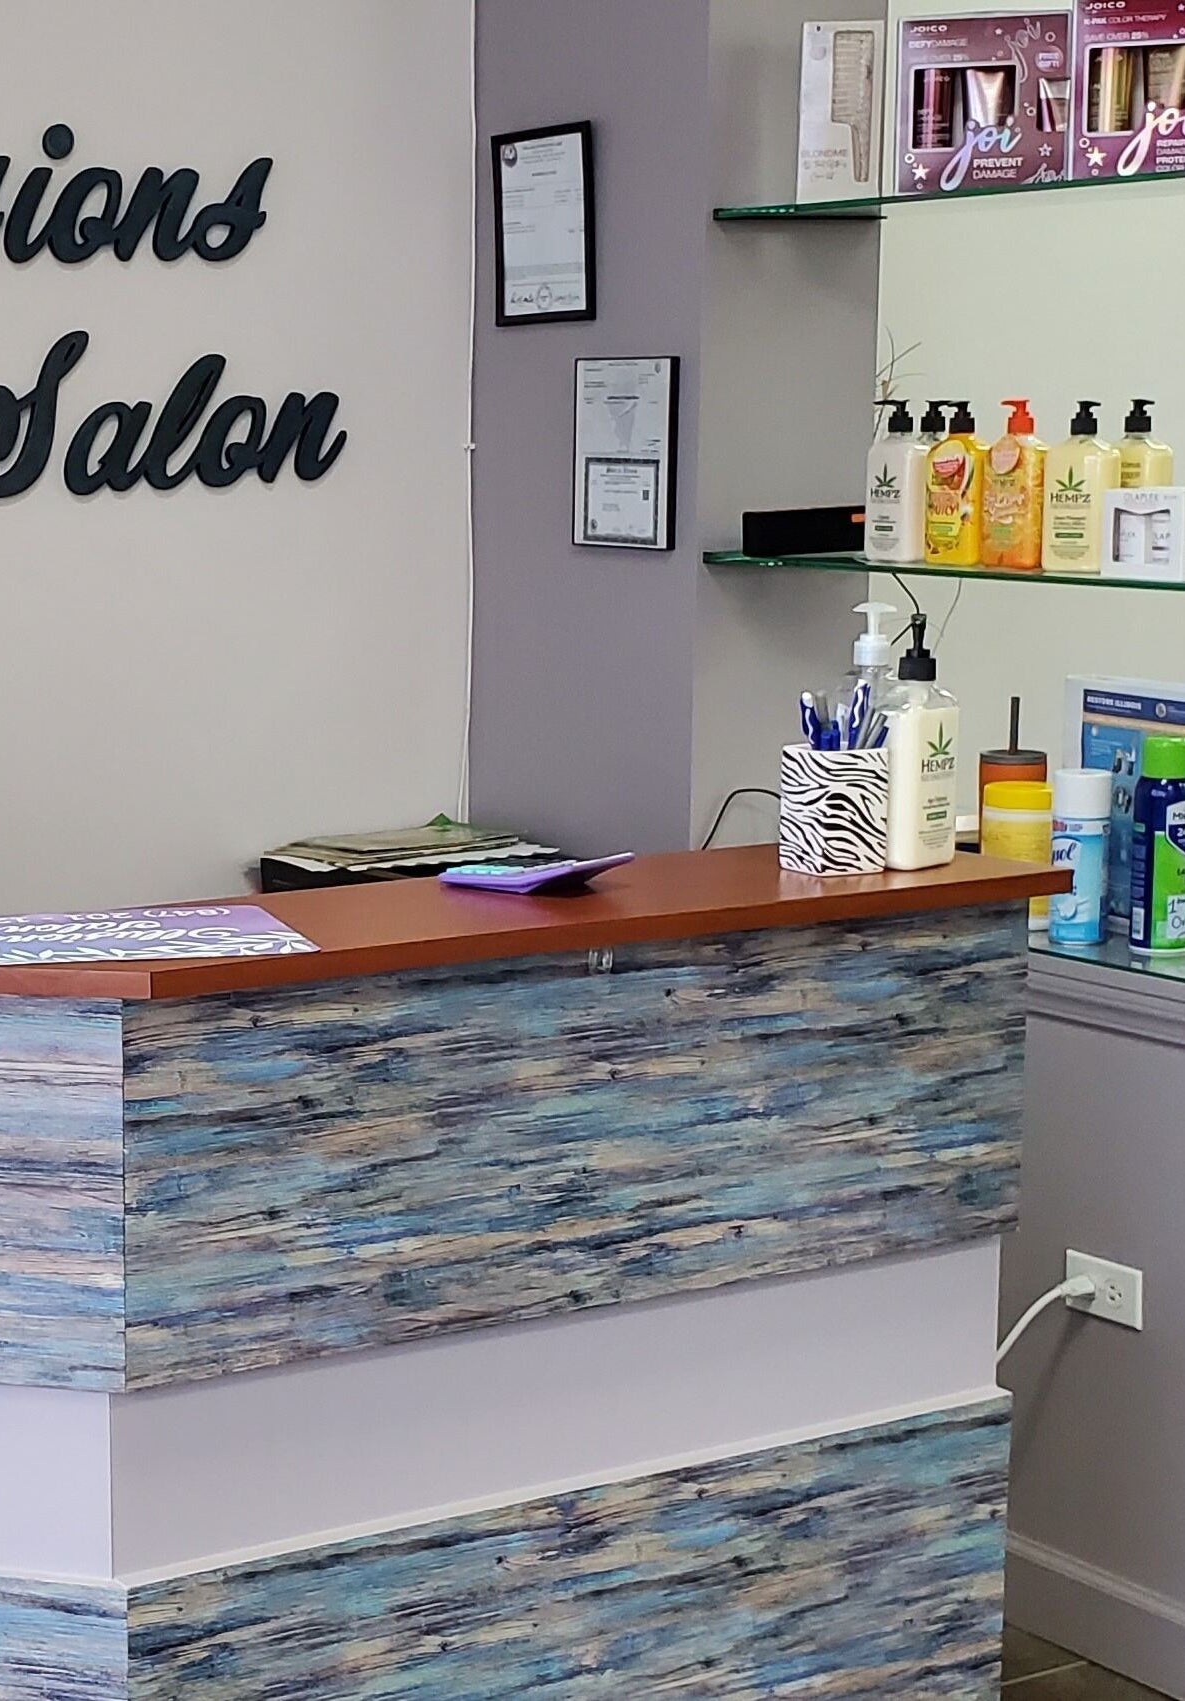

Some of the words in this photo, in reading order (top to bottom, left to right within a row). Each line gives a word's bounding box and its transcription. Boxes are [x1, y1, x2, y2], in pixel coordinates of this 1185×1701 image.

[1084, 1, 1126, 10] JOICO
[1108, 15, 1133, 24] COLOR
[909, 24, 948, 33] JOICO
[939, 115, 1023, 192] joi
[972, 157, 1023, 169] PREVENT
[972, 168, 1018, 180] DAMAGE
[870, 488, 901, 499] HEMPZ
[1050, 492, 1091, 504] HEMPZ
[921, 757, 955, 773] HEMPZ
[64, 911, 133, 921] 201
[142, 906, 233, 919] (847)
